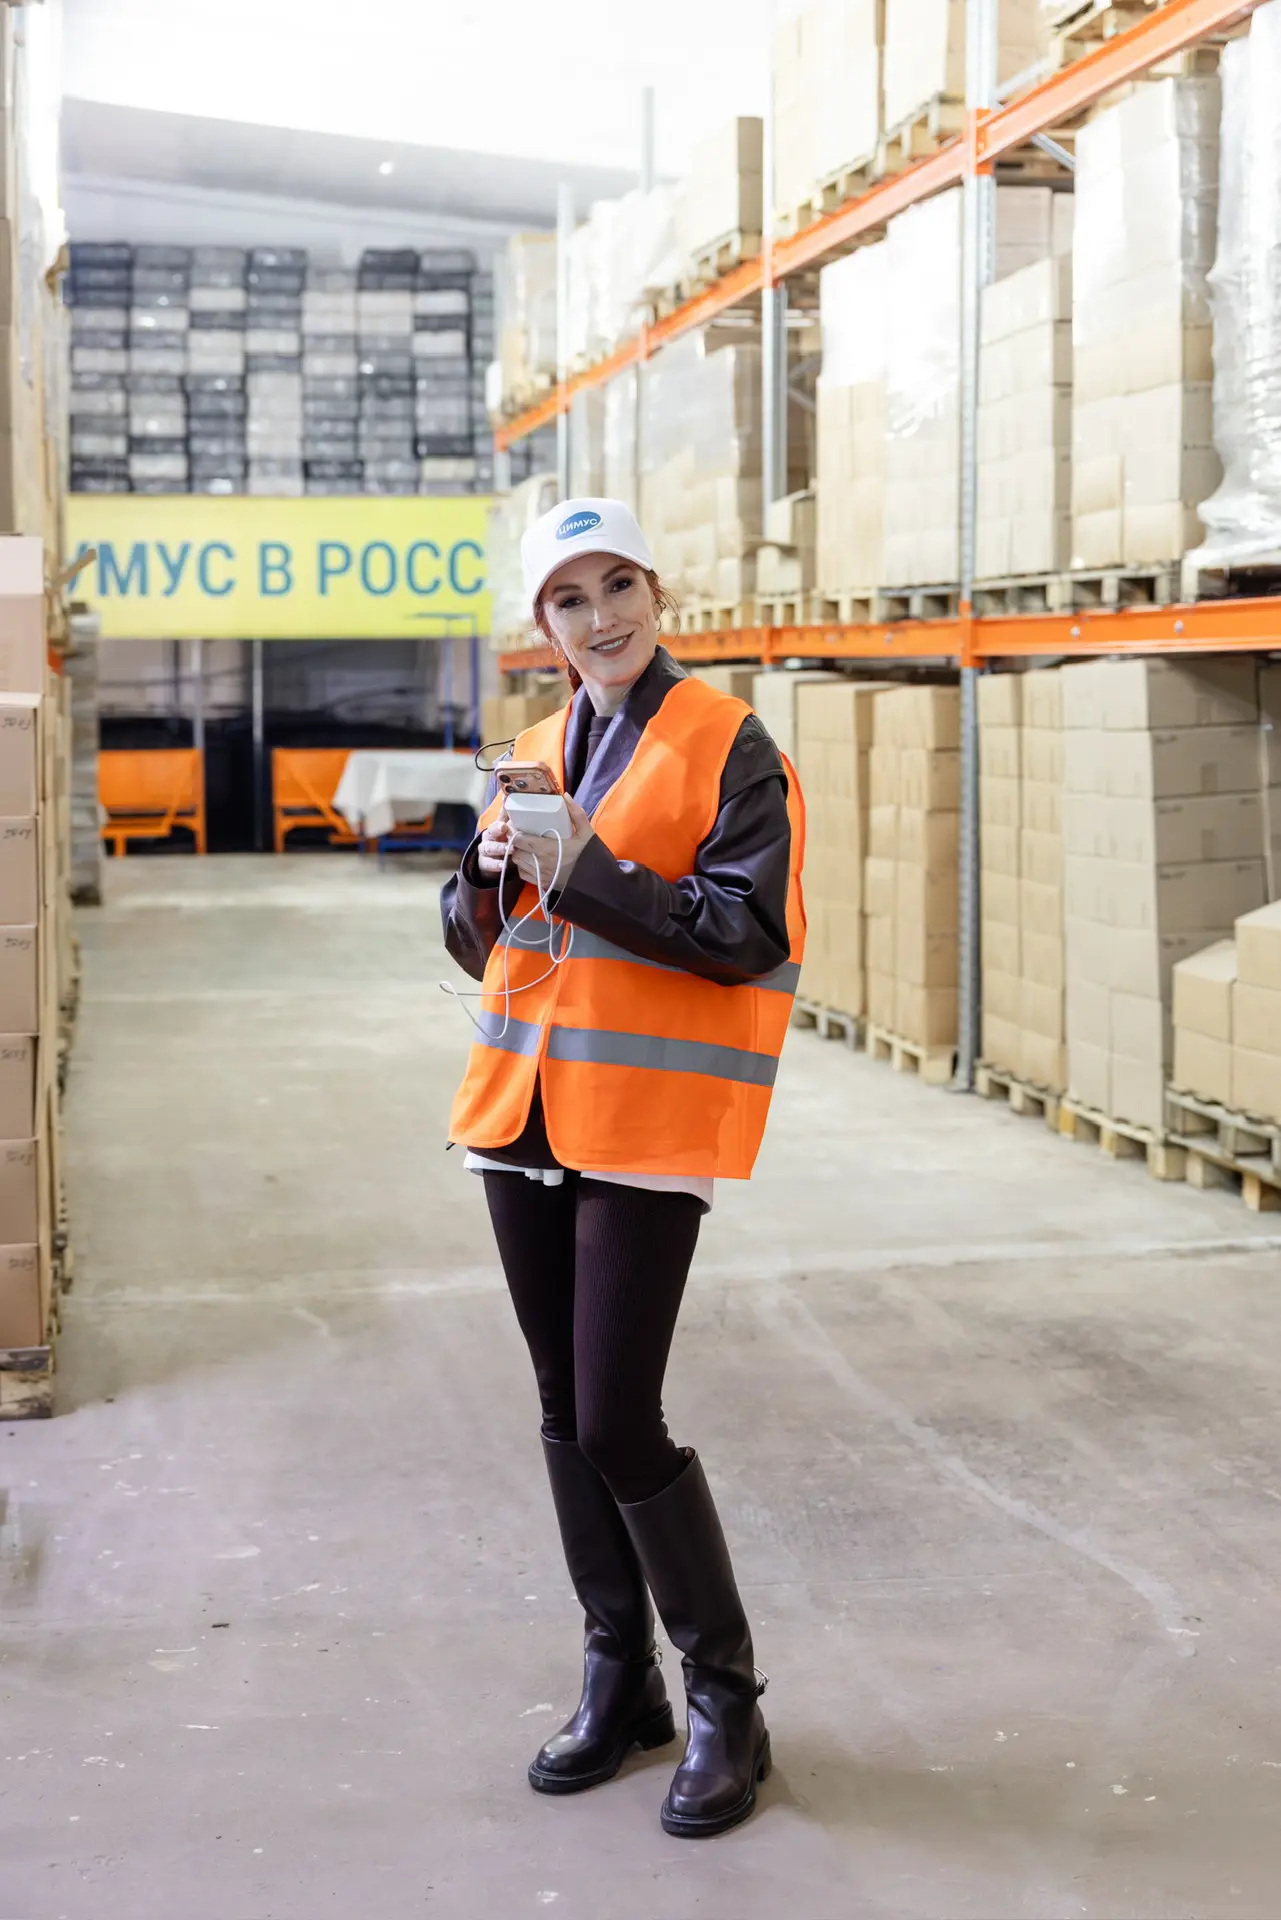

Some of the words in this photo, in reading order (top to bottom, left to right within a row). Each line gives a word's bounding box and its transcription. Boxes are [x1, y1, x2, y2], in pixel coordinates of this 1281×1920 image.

[559, 518, 598, 535] ЦИМУС
[258, 541, 293, 596] В
[317, 541, 485, 597] РОСС
